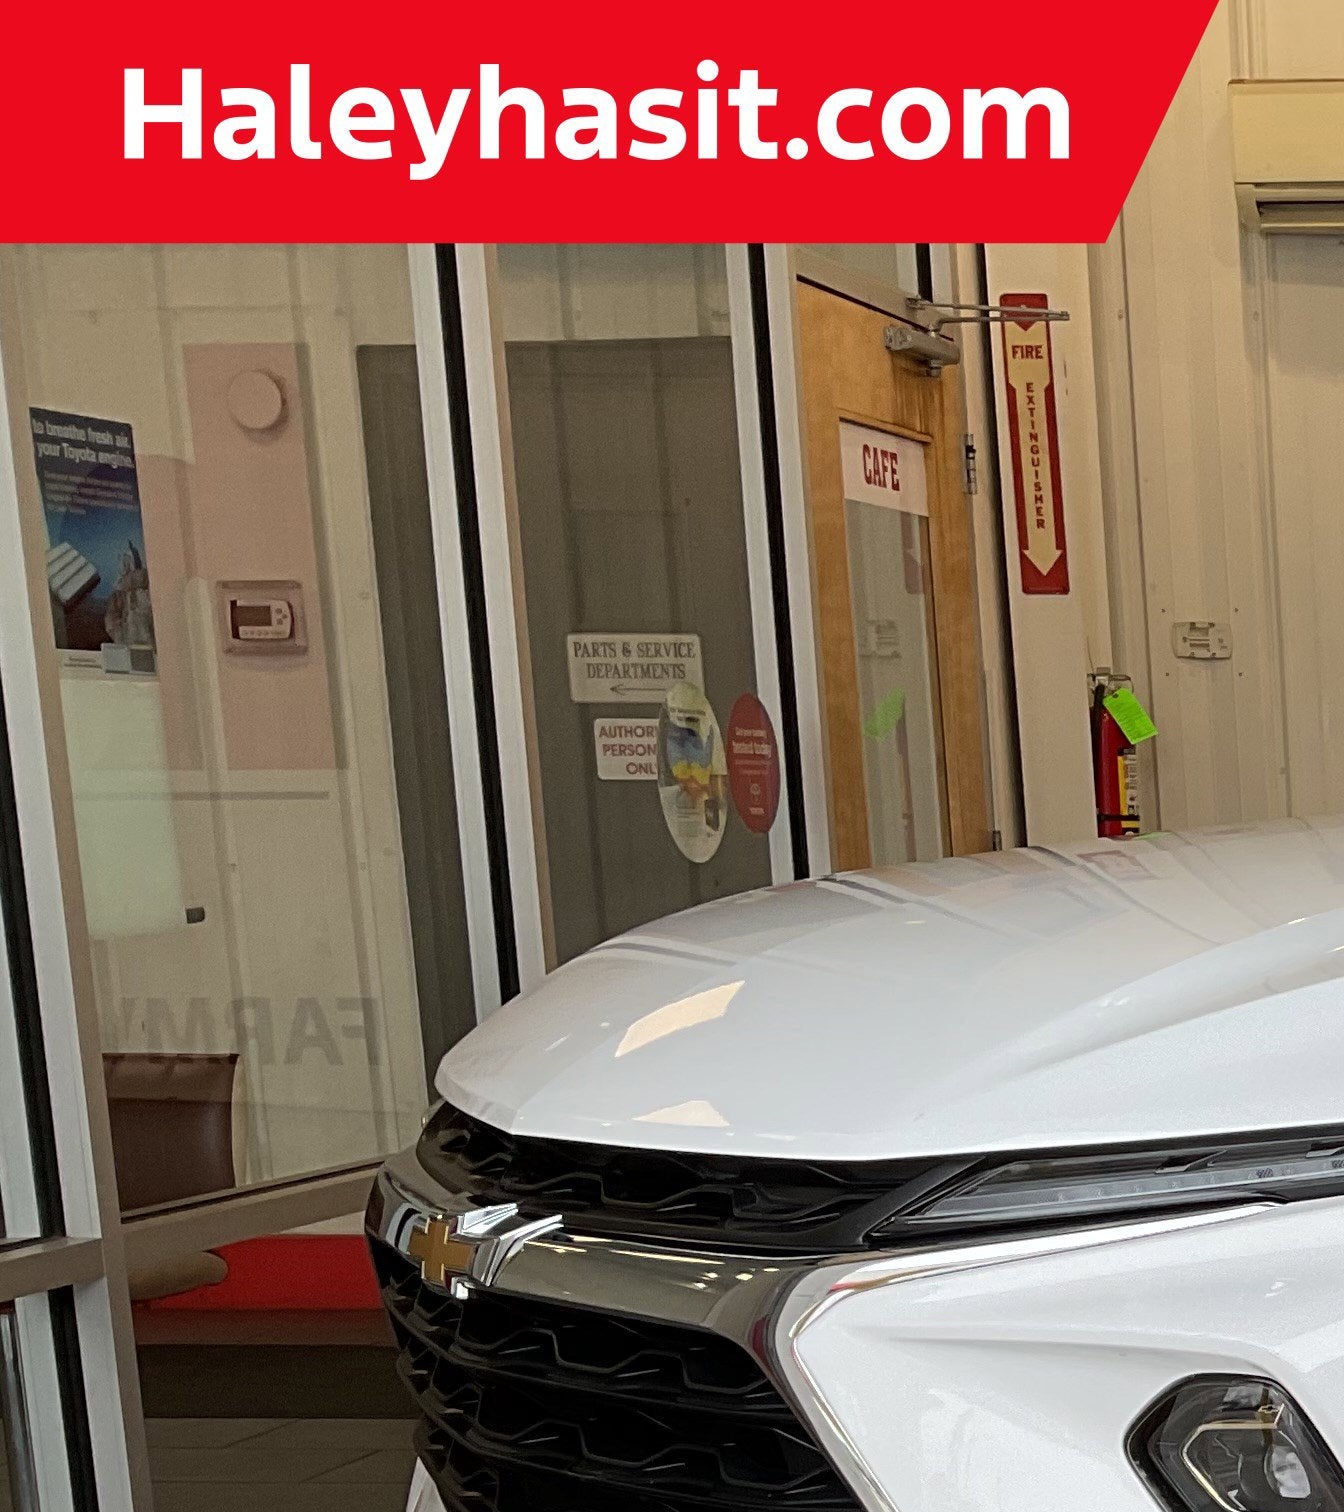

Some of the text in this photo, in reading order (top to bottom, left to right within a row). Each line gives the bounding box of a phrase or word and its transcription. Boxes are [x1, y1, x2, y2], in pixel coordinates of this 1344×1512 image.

[1011, 344, 1043, 360] FIRE
[62, 442, 98, 464] Toyota
[1025, 382, 1045, 530] EXTINGUISHER
[862, 443, 900, 492] CAFE
[573, 641, 695, 659] PARTS & SERVICE
[586, 662, 686, 680] DEPARTMENTS
[602, 744, 658, 757] PERSON
[625, 761, 658, 776] ONL
